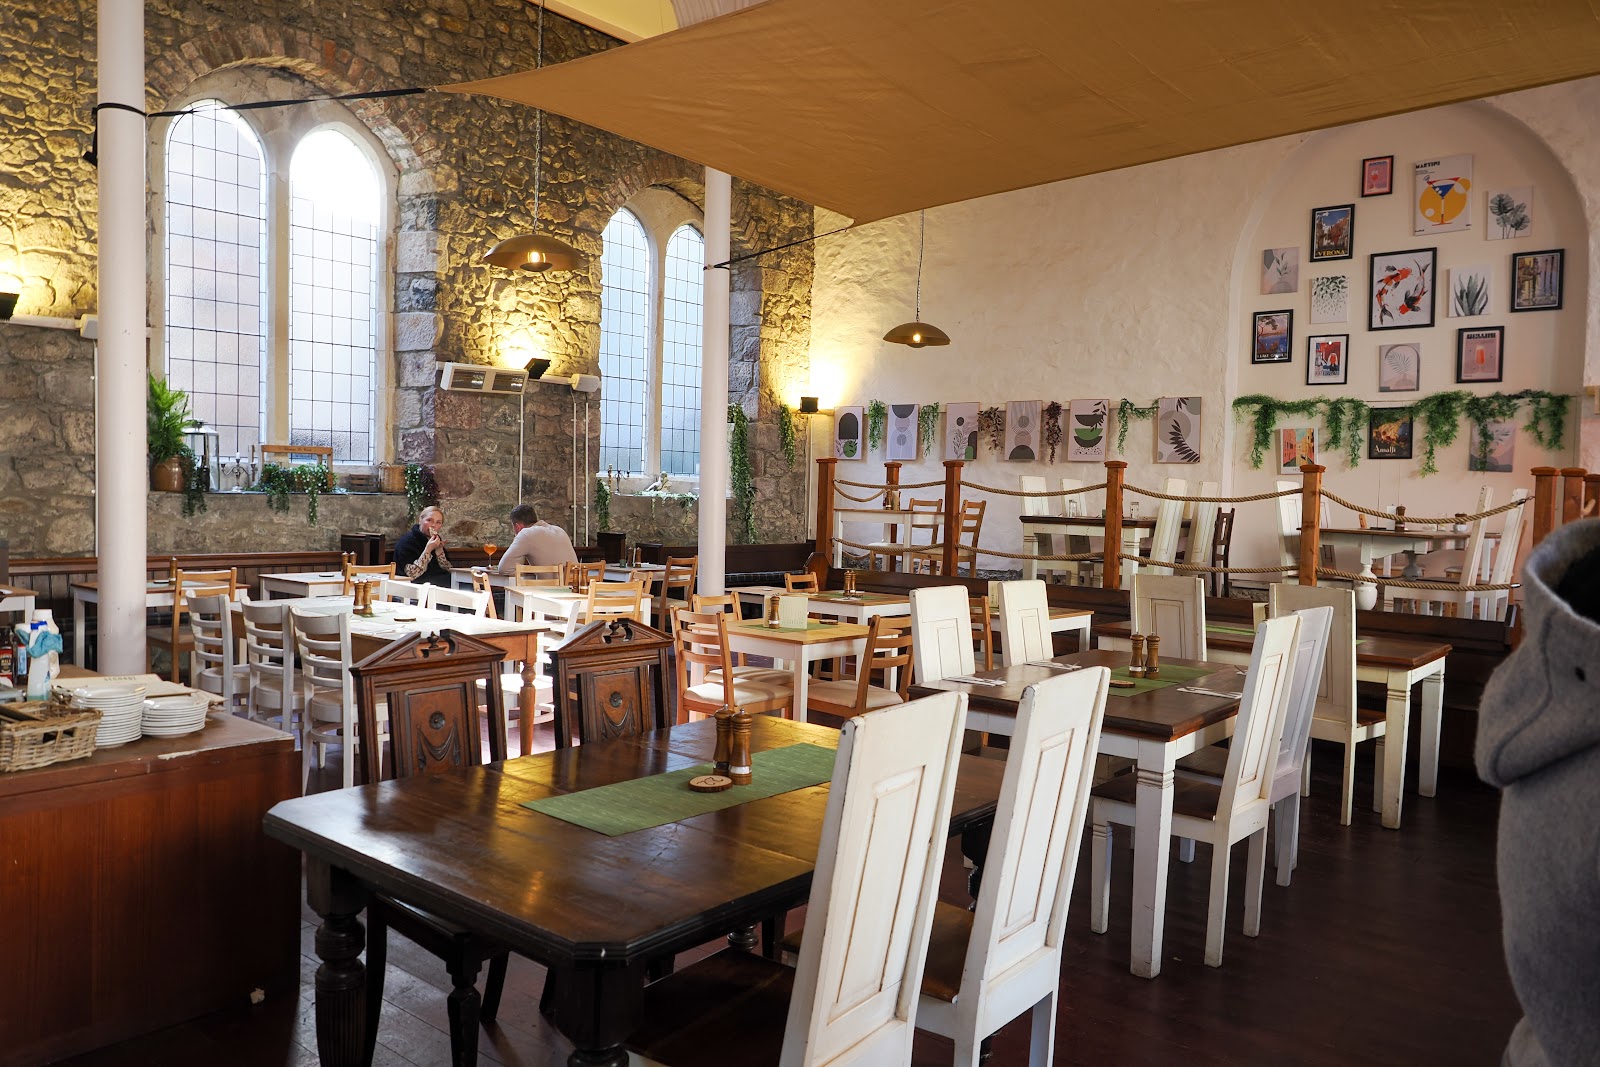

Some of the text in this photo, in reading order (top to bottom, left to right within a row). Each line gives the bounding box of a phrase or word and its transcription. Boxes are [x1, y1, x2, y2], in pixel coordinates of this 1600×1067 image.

[1415, 161, 1441, 169] MARTINI
[1317, 249, 1346, 257] VERONA
[1374, 444, 1397, 454] Amalfi
